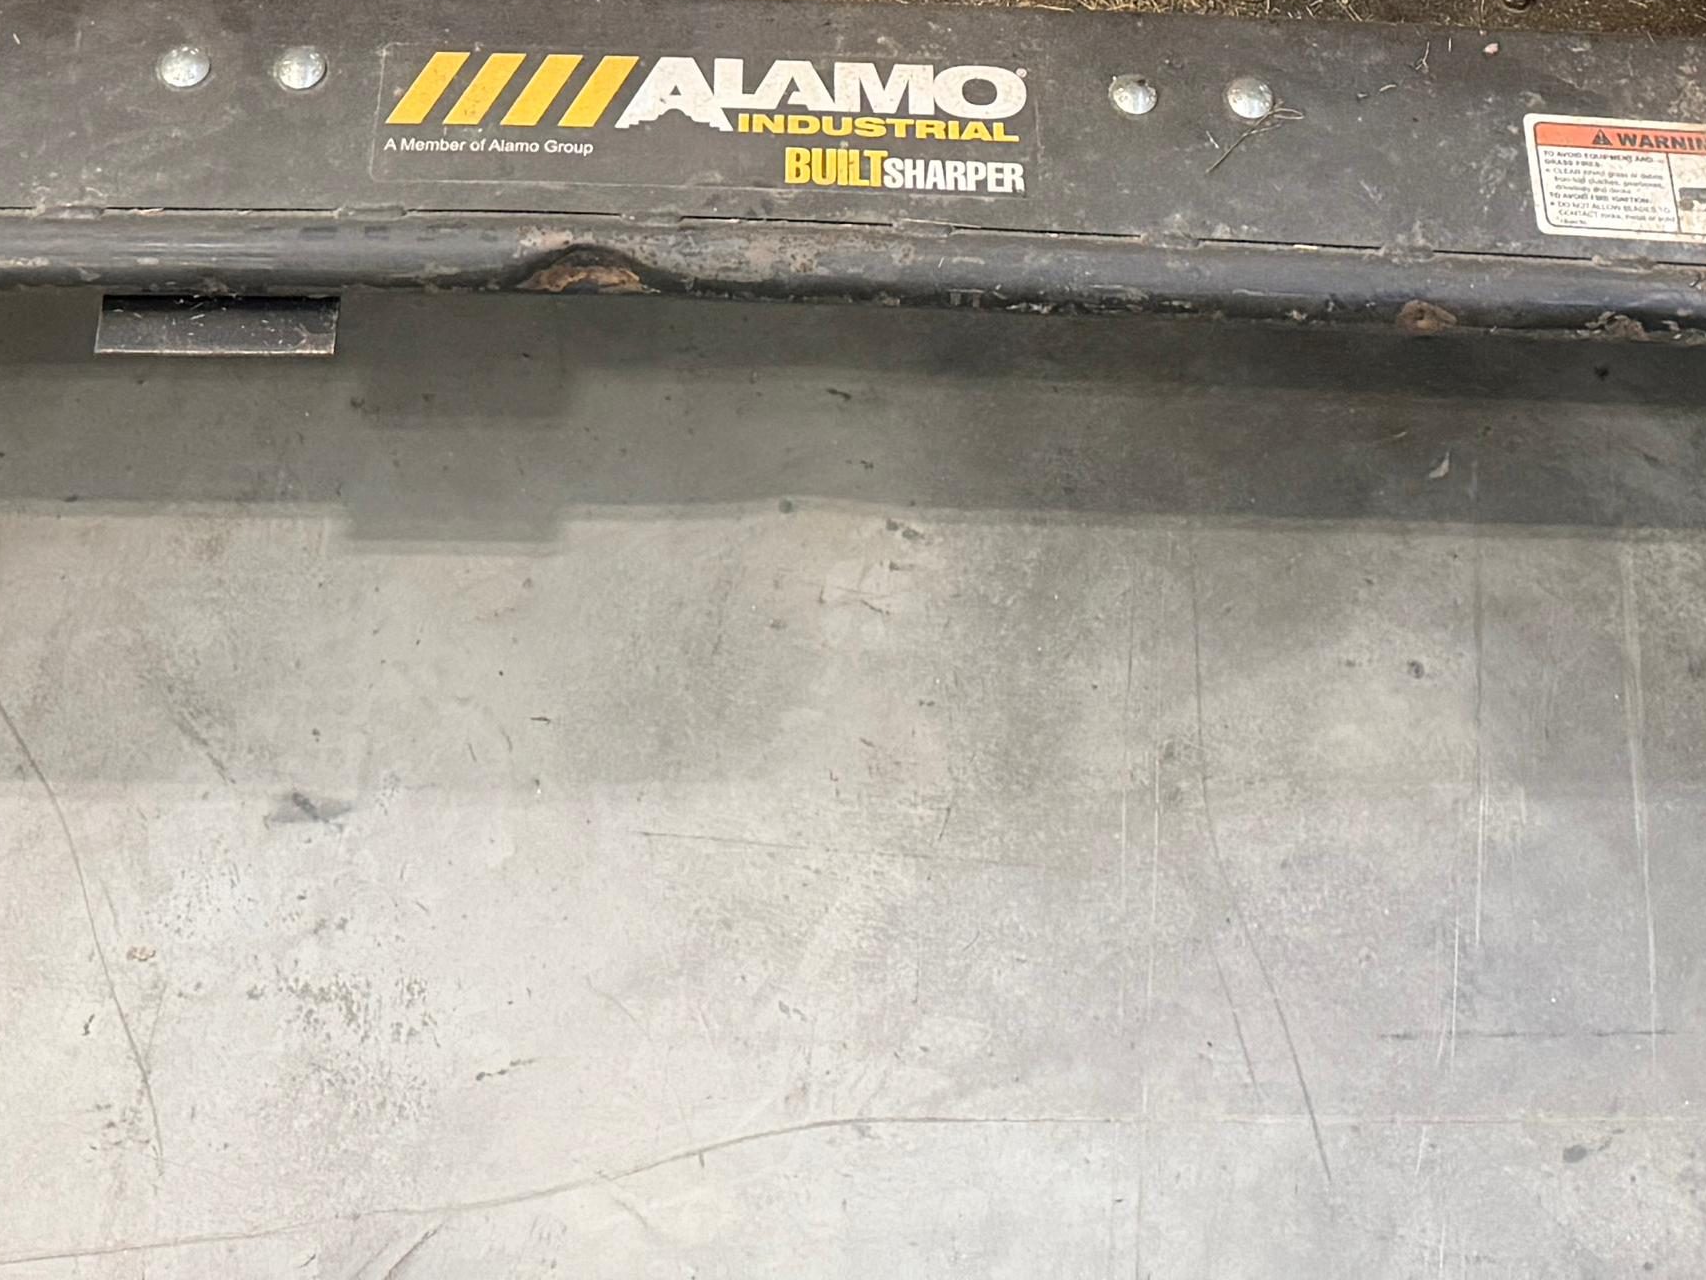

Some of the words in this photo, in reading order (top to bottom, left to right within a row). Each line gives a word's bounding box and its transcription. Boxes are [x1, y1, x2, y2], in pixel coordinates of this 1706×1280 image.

[616, 55, 1027, 131] ALAMO
[736, 113, 1020, 143] INDUSTRIAL
[384, 137, 397, 151] A
[400, 137, 465, 153] Member
[469, 137, 487, 152] of
[489, 138, 541, 154] Alamo
[544, 140, 594, 158] Group
